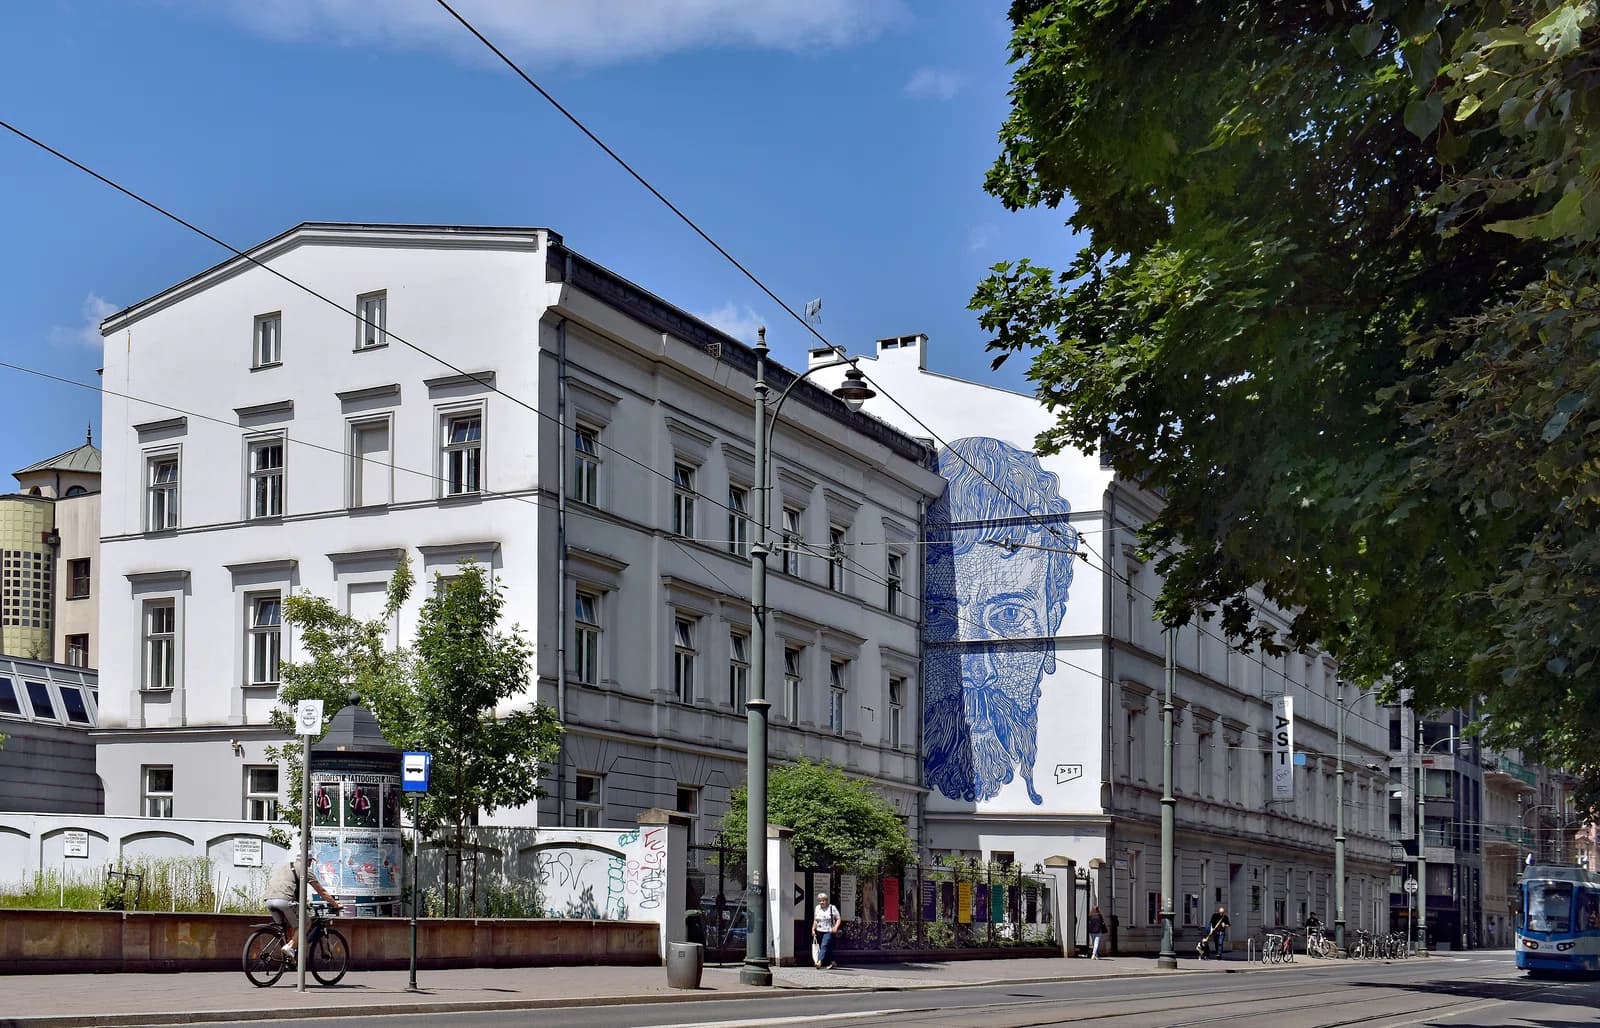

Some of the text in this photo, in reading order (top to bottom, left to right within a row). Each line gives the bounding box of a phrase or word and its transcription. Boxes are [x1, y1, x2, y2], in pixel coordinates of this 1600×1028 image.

[1275, 715, 1290, 765] AST
[1060, 767, 1078, 775] AST
[348, 774, 381, 784] TATTOOFEST
